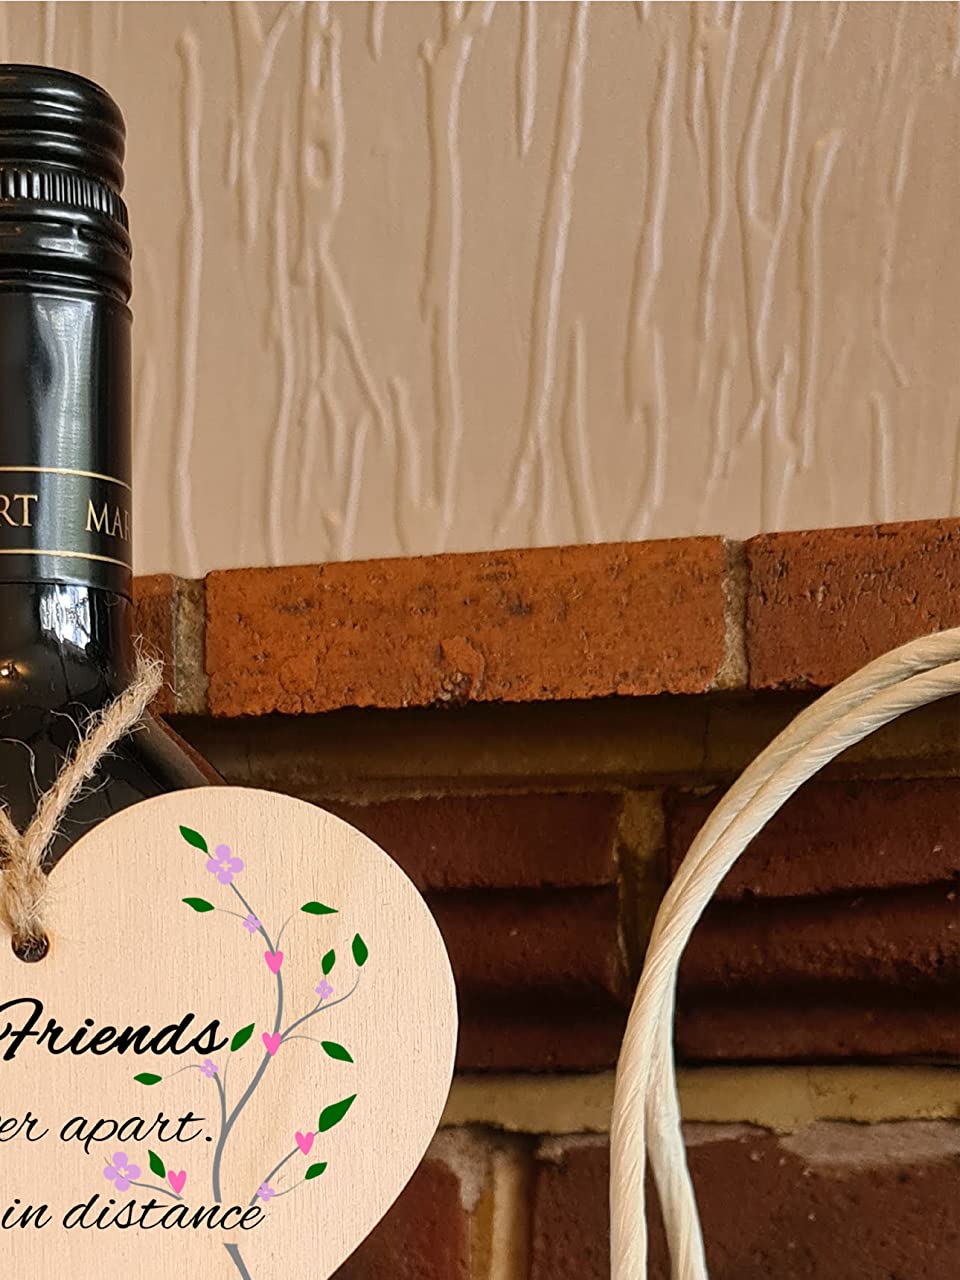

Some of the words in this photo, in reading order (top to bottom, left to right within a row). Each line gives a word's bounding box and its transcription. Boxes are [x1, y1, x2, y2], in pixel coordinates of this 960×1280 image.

[59, 1111, 214, 1155] apart.
[1, 1199, 53, 1230] in
[62, 1193, 266, 1231] distance
